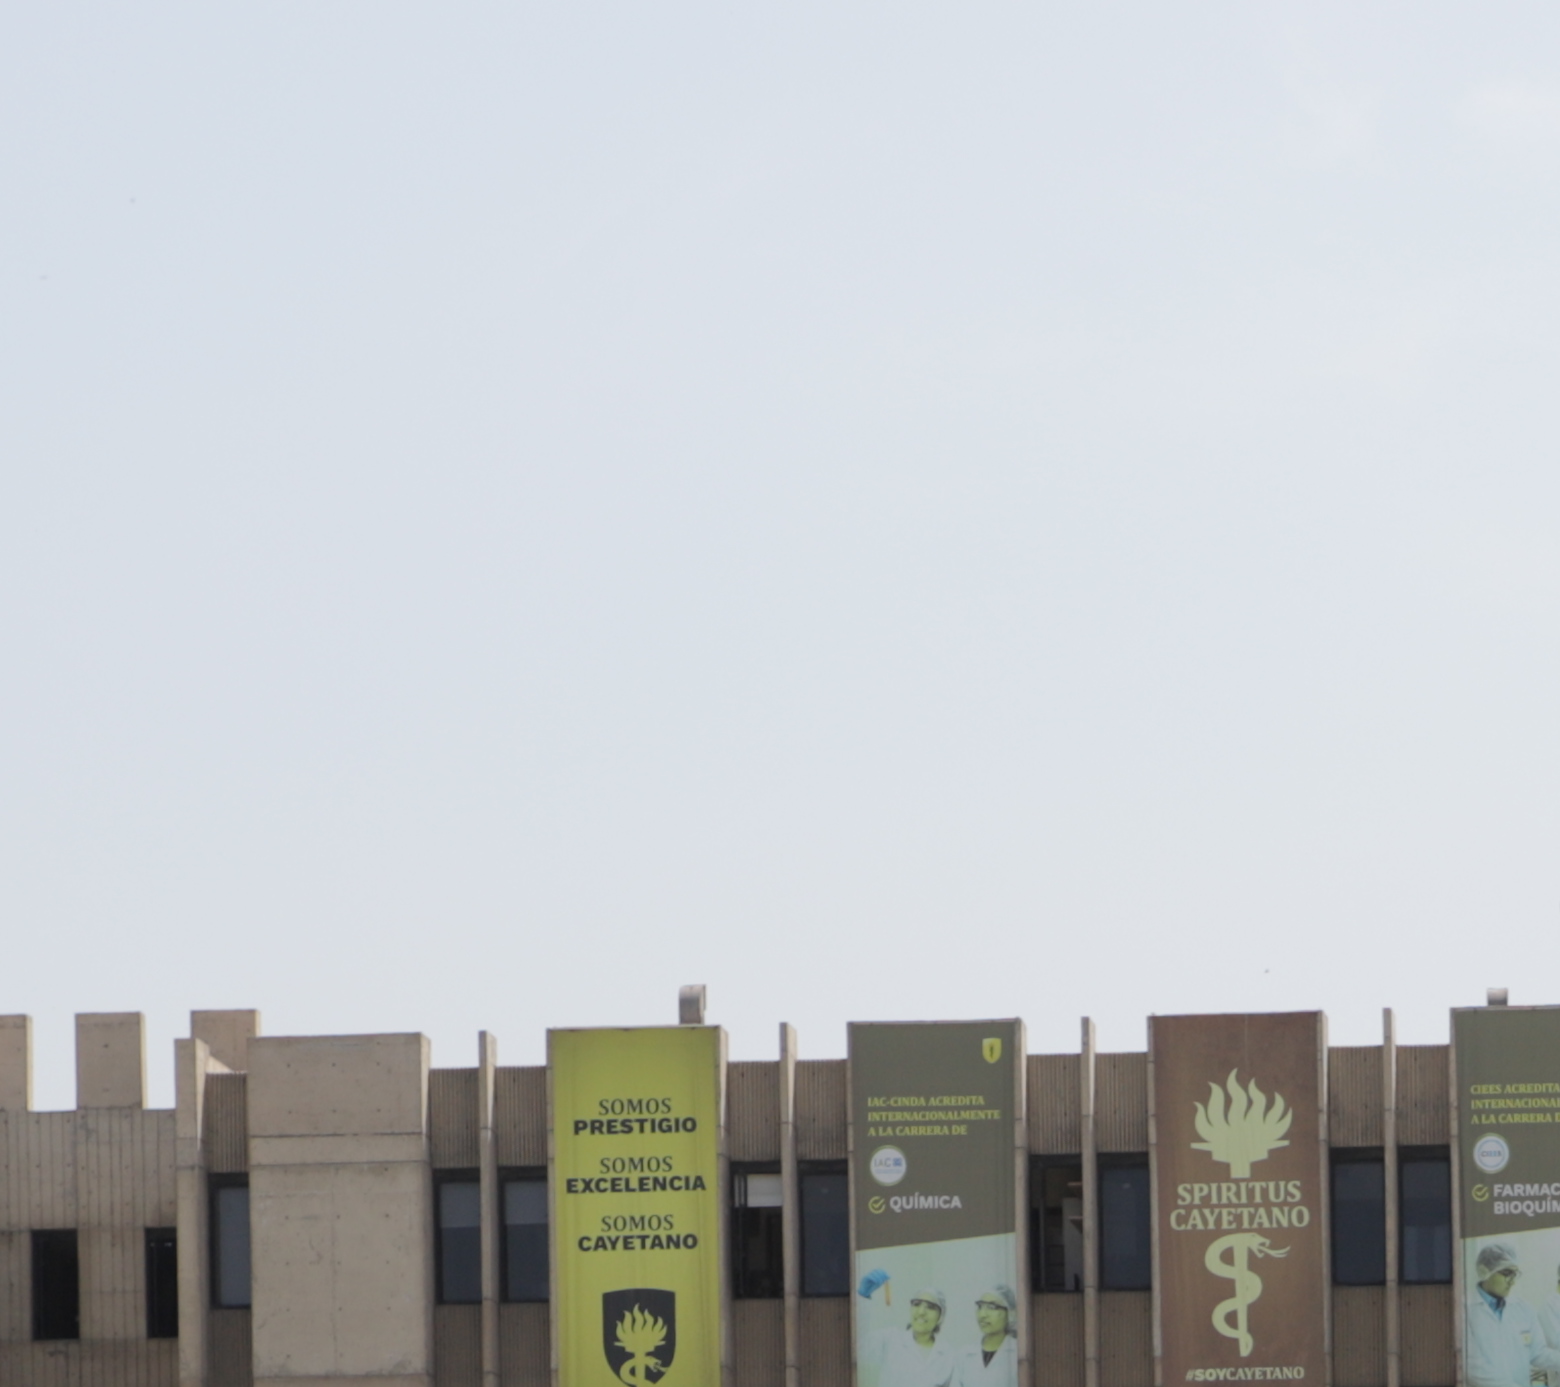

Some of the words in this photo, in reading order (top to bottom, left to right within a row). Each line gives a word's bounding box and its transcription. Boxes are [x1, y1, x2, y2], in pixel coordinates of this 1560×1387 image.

[1470, 1084, 1502, 1095] CIEES
[1504, 1083, 1560, 1094] ACREDITA
[598, 1098, 672, 1115] SOMOS
[867, 1096, 927, 1107] IAC-CINDA
[928, 1095, 985, 1106] ACREDITA
[867, 1110, 1001, 1121] INTERNACIONALMENTE
[1471, 1115, 1479, 1125] A
[1481, 1114, 1496, 1124] LA
[1498, 1113, 1552, 1123] CARRERA
[573, 1117, 697, 1135] PRESTIGIO
[868, 1127, 876, 1136] A
[878, 1126, 893, 1136] LA
[896, 1125, 950, 1136] CARRERA
[952, 1125, 968, 1135] DE
[600, 1156, 673, 1174] SOMOS
[566, 1175, 706, 1193] EXCELENCIA
[1176, 1180, 1302, 1205] SPIRITUS
[890, 1192, 962, 1213] QUÍMICA
[601, 1214, 674, 1232] SOMOS
[1170, 1206, 1310, 1230] CAYETANO
[578, 1233, 698, 1252] CAYETANO
[1186, 1366, 1305, 1382] #SOYCAYETANO
